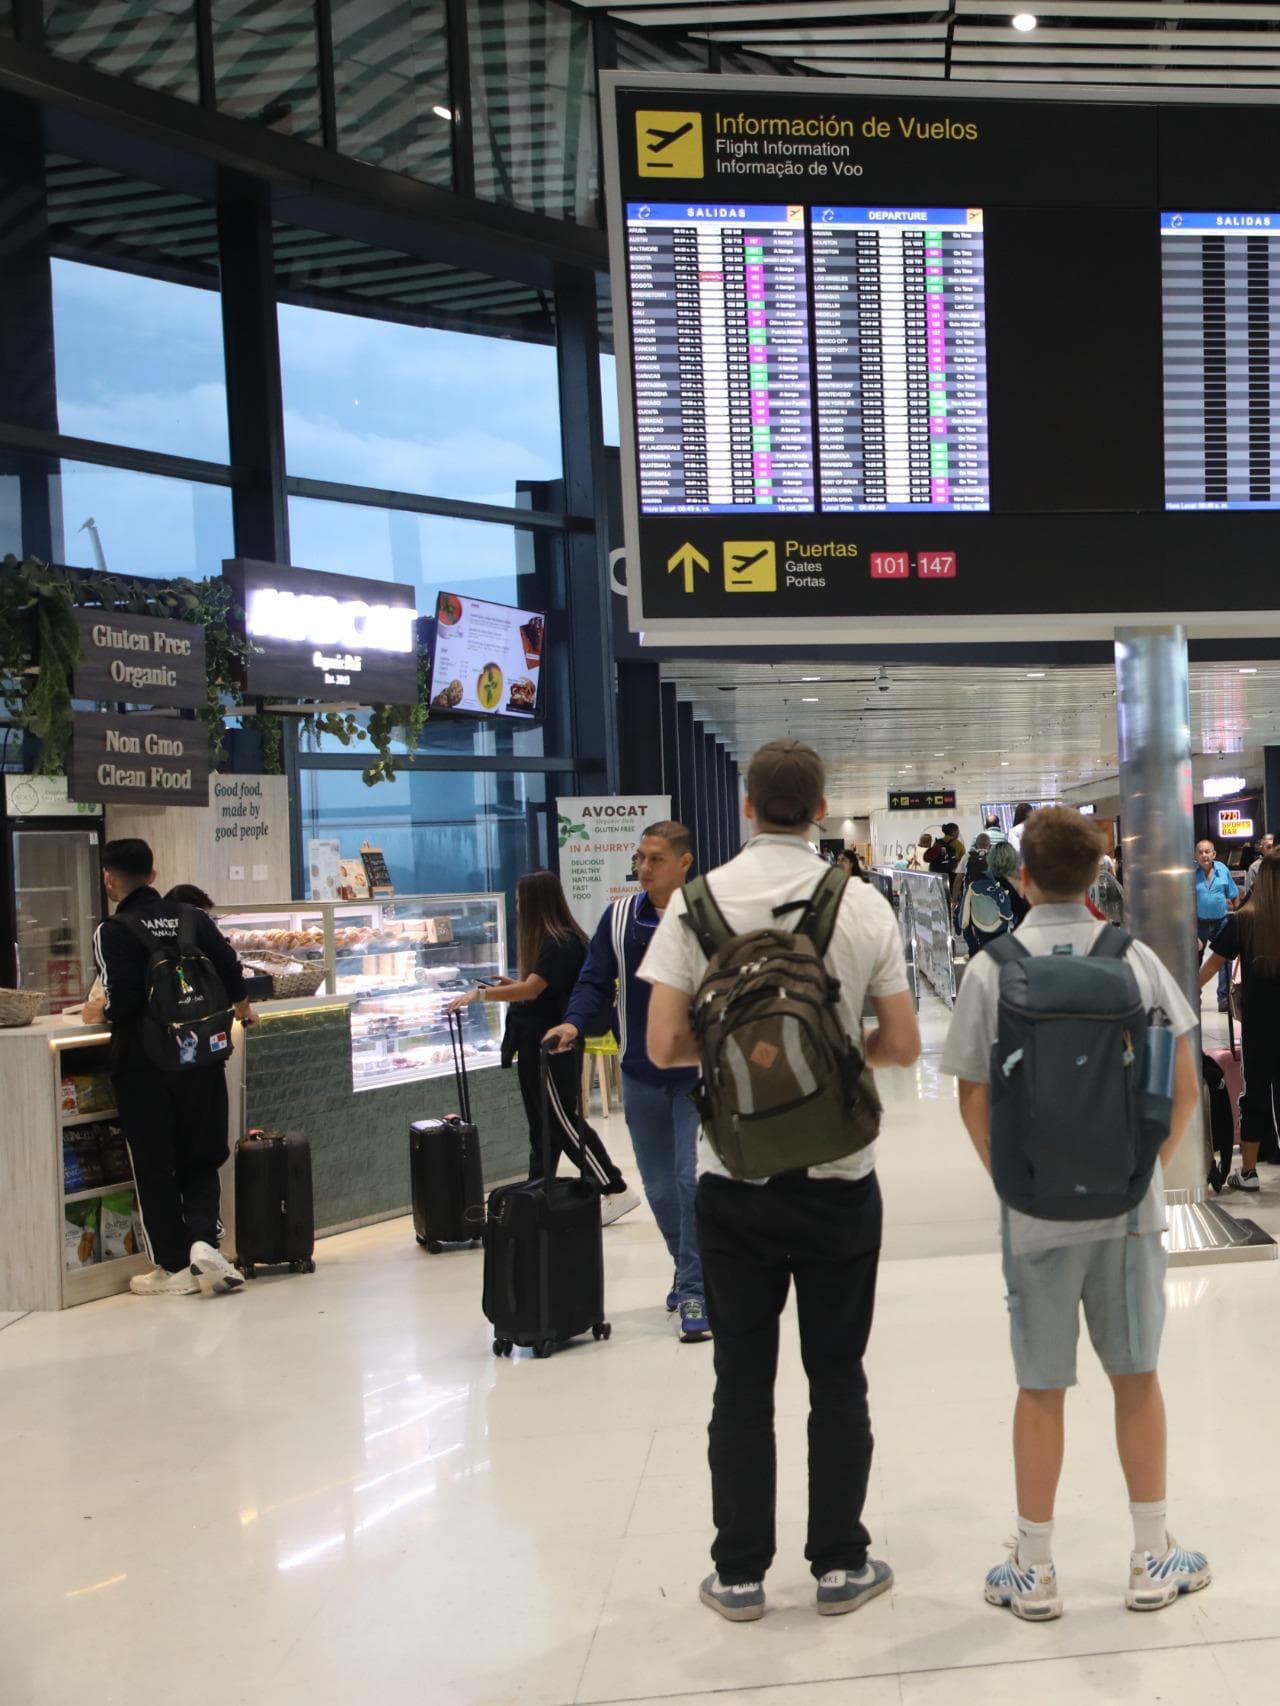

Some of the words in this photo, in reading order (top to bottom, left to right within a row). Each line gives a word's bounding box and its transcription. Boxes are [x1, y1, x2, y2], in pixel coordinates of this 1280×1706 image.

[715, 111, 854, 138] Información
[862, 117, 891, 139] de
[898, 118, 978, 141] Vuelos
[716, 140, 759, 159] Flight
[764, 141, 850, 157] Information
[716, 159, 804, 178] Informação
[808, 160, 827, 175] de
[832, 161, 863, 176] Voo
[687, 208, 746, 218] SALIDAS
[868, 211, 927, 221] DEPARTURE
[1216, 217, 1271, 226] SALIDAS
[785, 541, 857, 557] Puertas
[785, 561, 822, 573] Gates
[874, 557, 906, 573] 101
[920, 557, 953, 573] 147
[786, 576, 826, 588] Portas
[92, 625, 150, 652] Gluten
[152, 632, 192, 656] Free
[110, 660, 177, 688] Organic
[105, 730, 140, 754] Non
[145, 734, 184, 757] Gmo
[97, 764, 147, 787] Clean
[150, 768, 192, 790] Food
[214, 783, 238, 797] Good
[239, 782, 263, 800] food,
[222, 804, 247, 817] made
[249, 804, 260, 820] by
[582, 805, 648, 817] AVOCAT
[215, 825, 238, 841] good
[240, 825, 268, 841] people
[570, 845, 581, 853] IN
[595, 843, 636, 852] HURRY?
[609, 886, 641, 894] BREAKFAS
